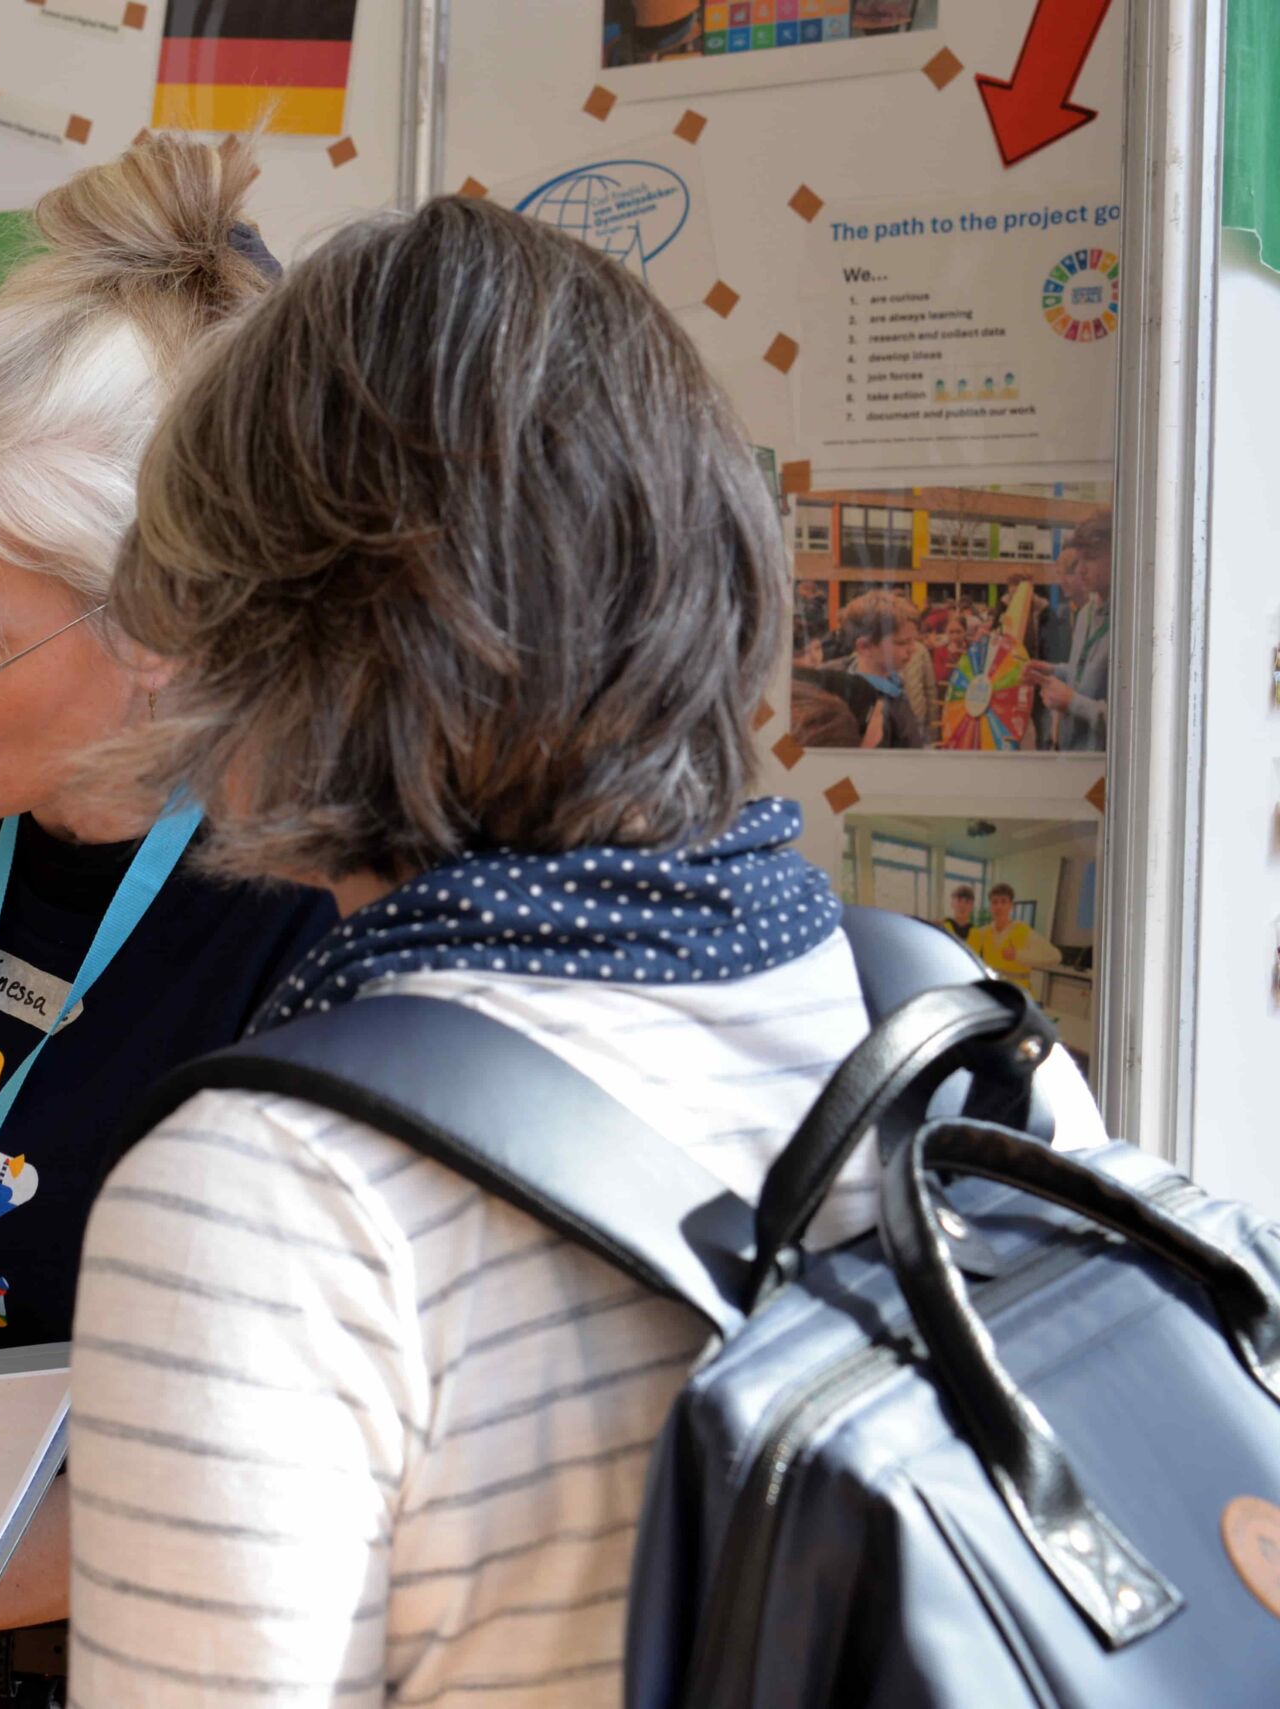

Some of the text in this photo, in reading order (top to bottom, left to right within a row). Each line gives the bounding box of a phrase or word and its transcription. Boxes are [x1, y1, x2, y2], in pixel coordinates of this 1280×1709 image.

[830, 205, 1088, 242] The path to the project
[870, 293, 930, 304] are curious
[870, 310, 973, 324] are always learning
[869, 327, 1006, 343] research and collect data
[869, 350, 943, 363] develop ideas
[867, 371, 923, 384] join forces
[867, 390, 927, 402] take action
[866, 404, 1037, 421] document and publish our work
